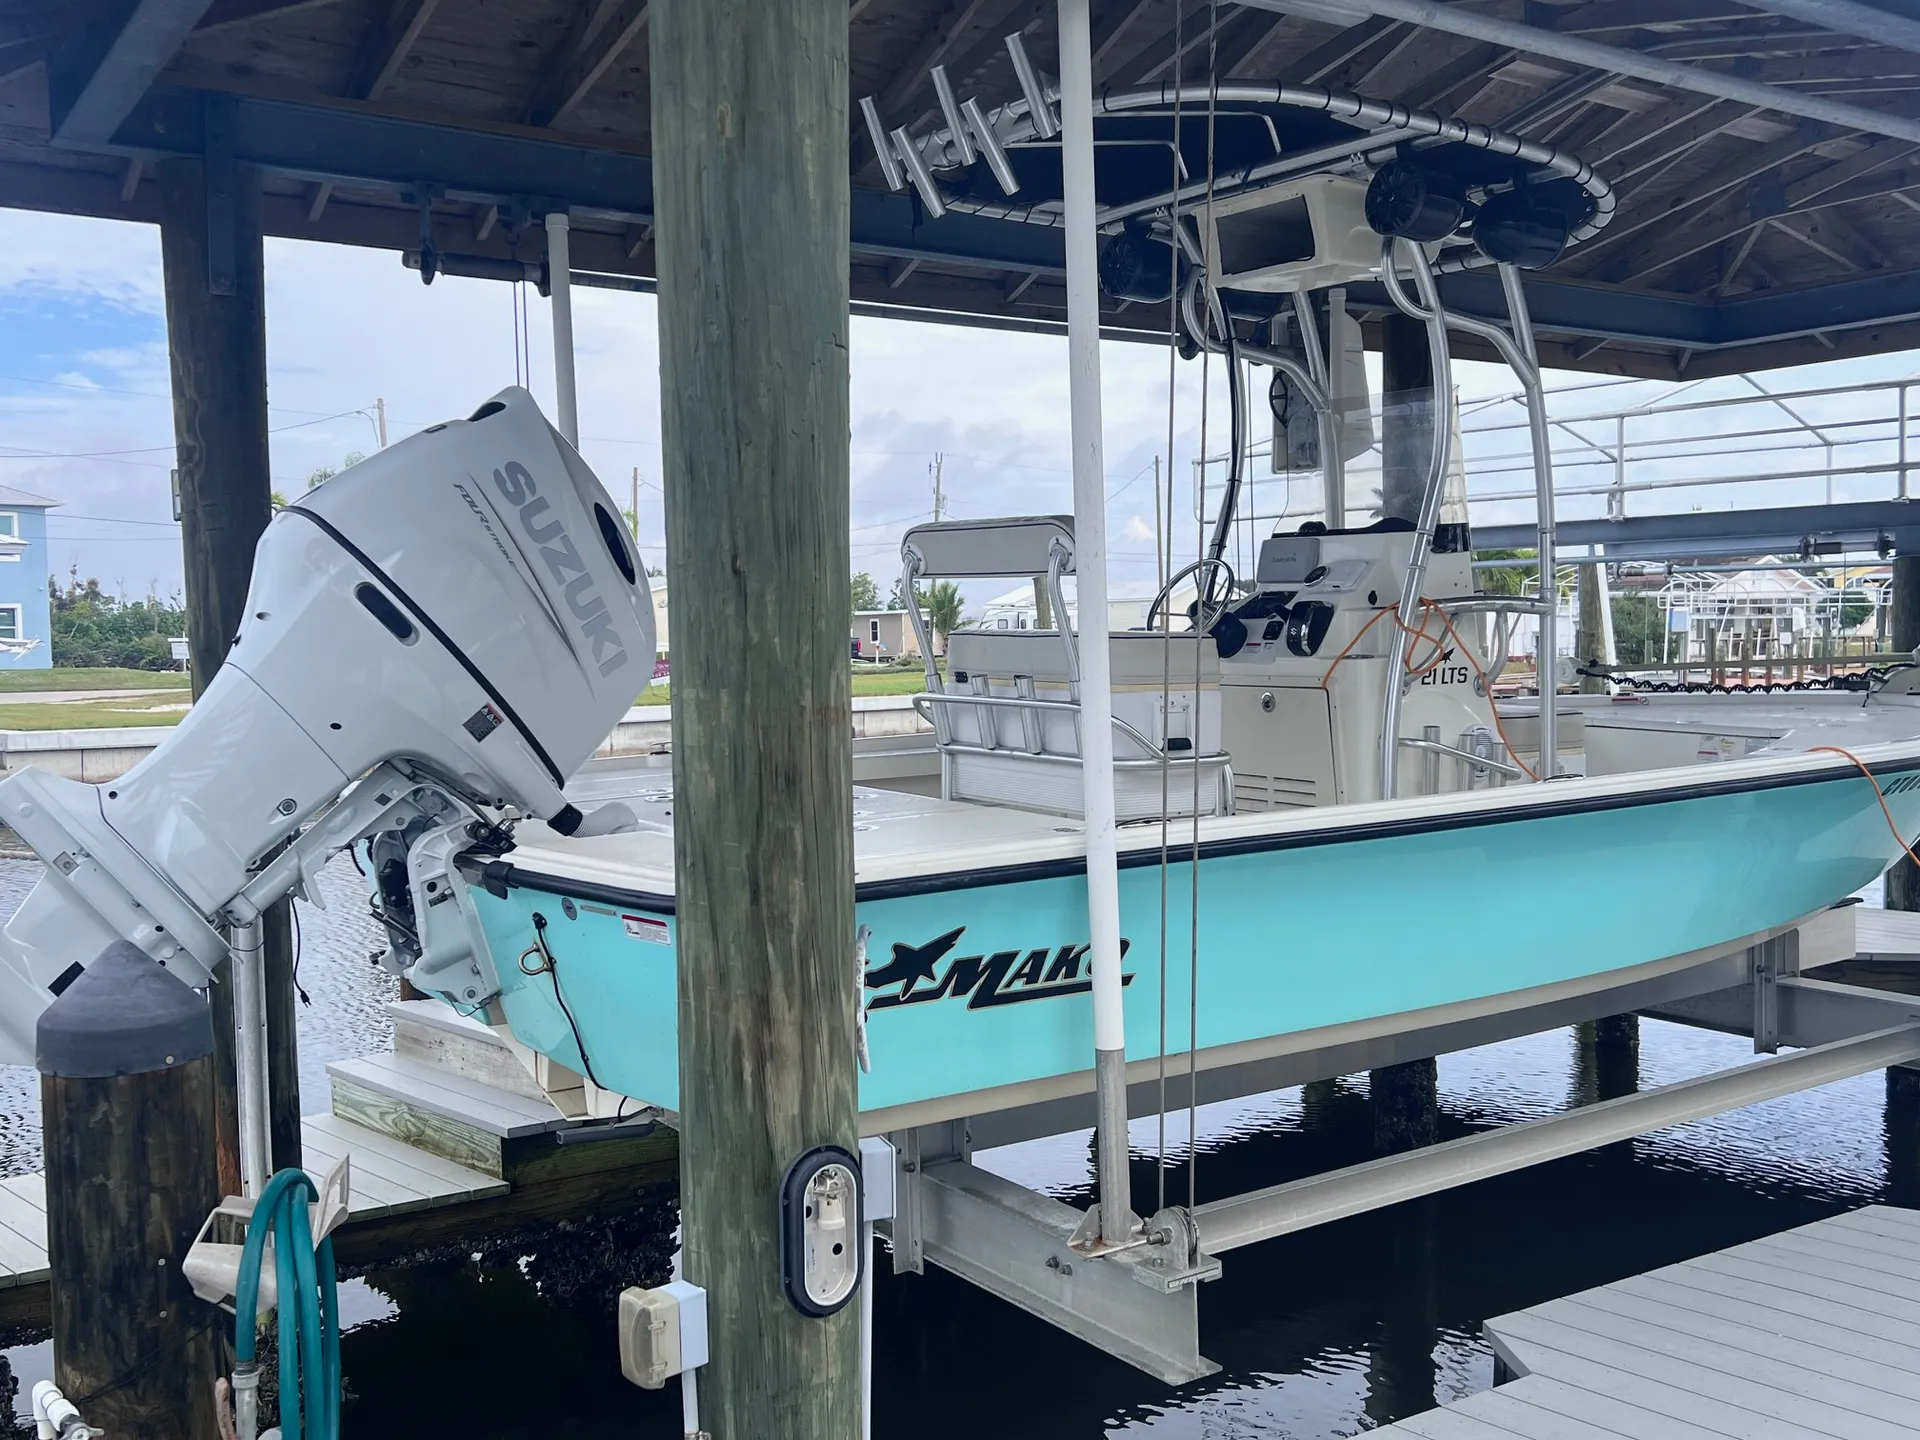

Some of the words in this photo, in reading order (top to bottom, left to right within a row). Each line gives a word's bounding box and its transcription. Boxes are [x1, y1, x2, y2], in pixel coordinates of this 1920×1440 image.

[493, 461, 628, 678] SUZUKI
[1421, 668, 1437, 685] 21
[1441, 667, 1468, 685] LTS
